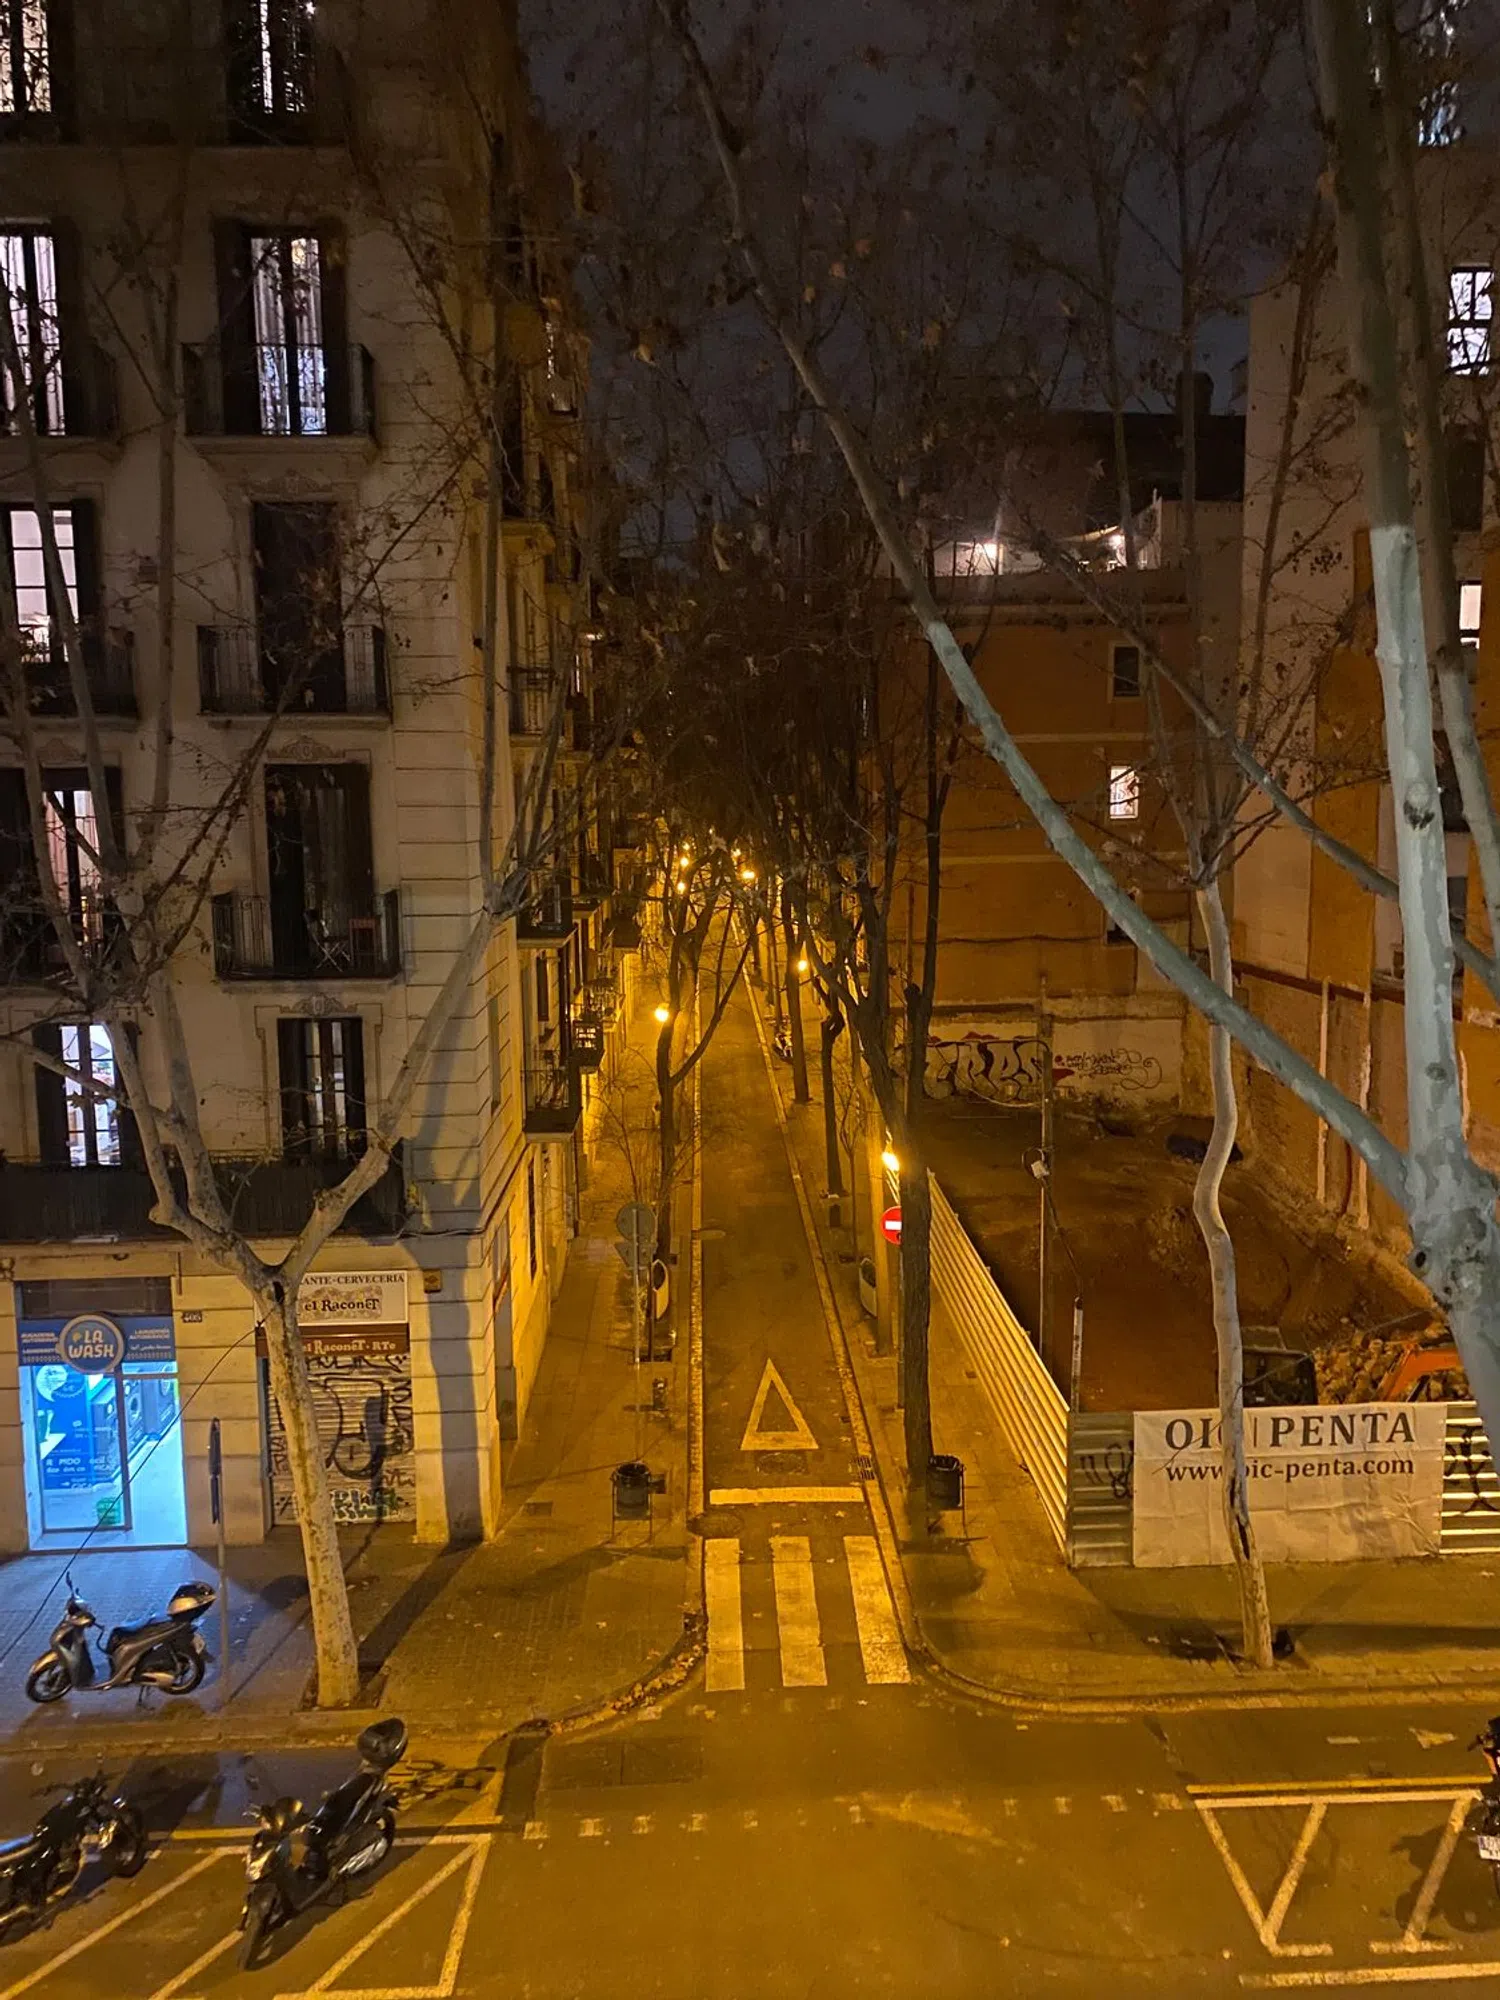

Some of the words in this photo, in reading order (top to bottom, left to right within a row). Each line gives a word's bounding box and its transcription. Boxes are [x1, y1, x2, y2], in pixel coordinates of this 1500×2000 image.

[84, 1330, 104, 1343] LA
[68, 1345, 115, 1358] WASH
[1165, 1417, 1222, 1450] OI
[1270, 1412, 1415, 1448] PENTA
